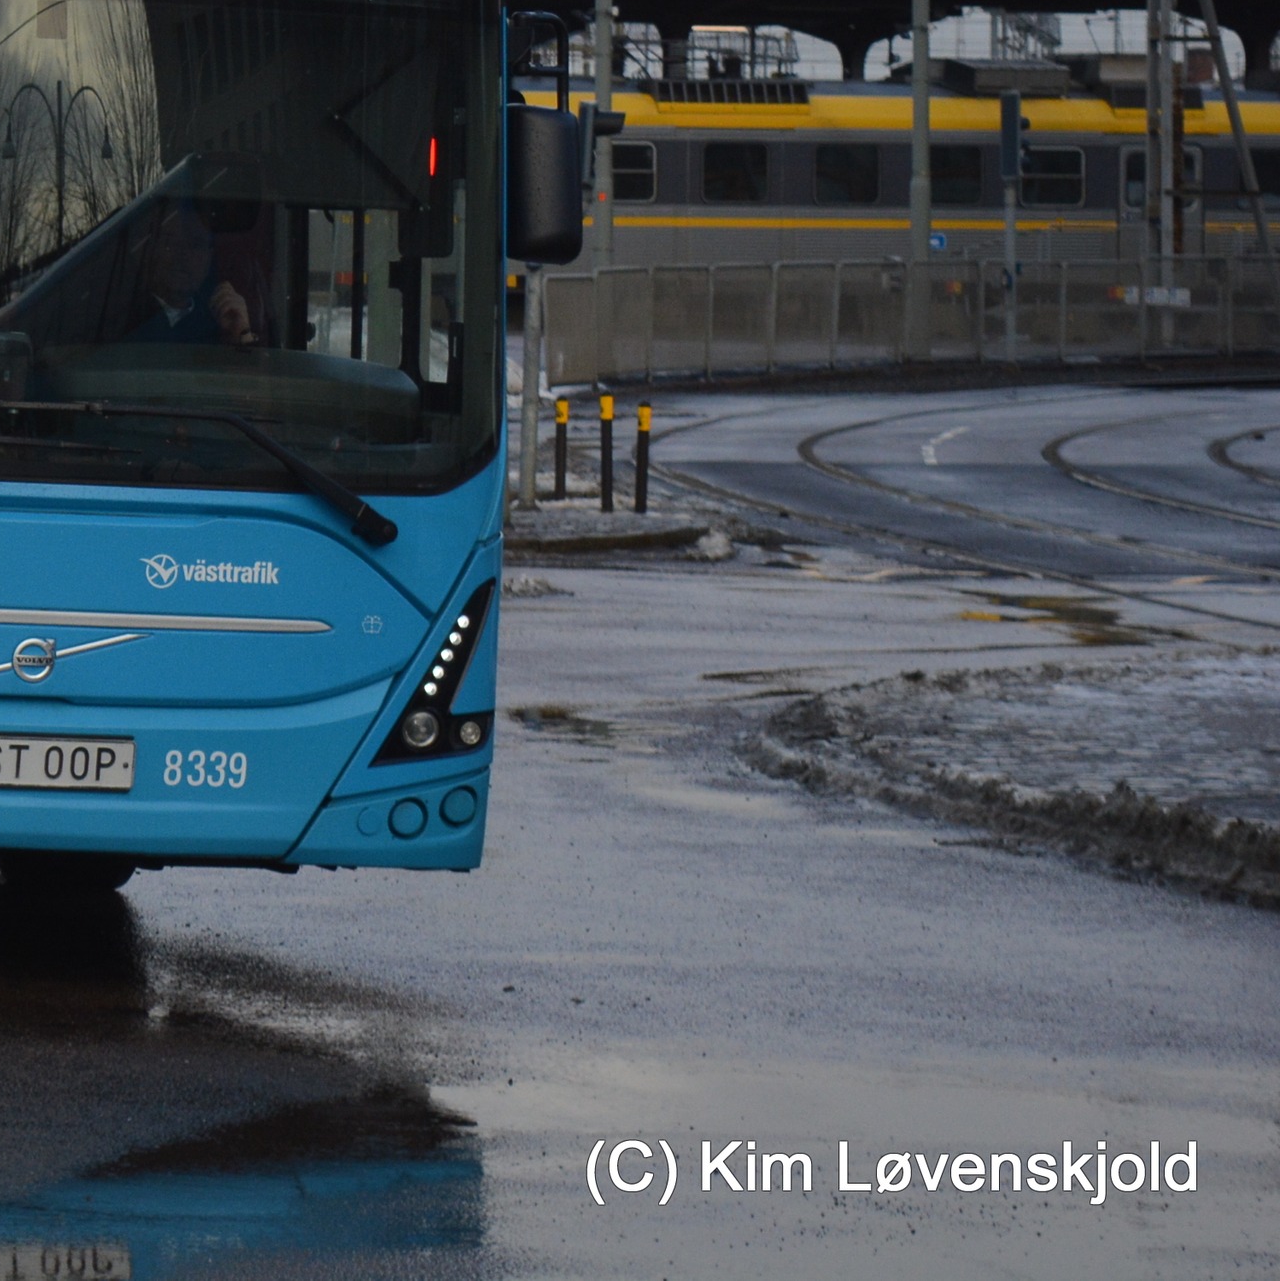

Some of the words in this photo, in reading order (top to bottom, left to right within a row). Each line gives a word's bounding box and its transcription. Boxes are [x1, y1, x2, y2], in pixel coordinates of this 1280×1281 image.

[182, 559, 279, 584] västtrafik
[16, 656, 53, 665] VOLVO
[163, 749, 247, 789] 8339
